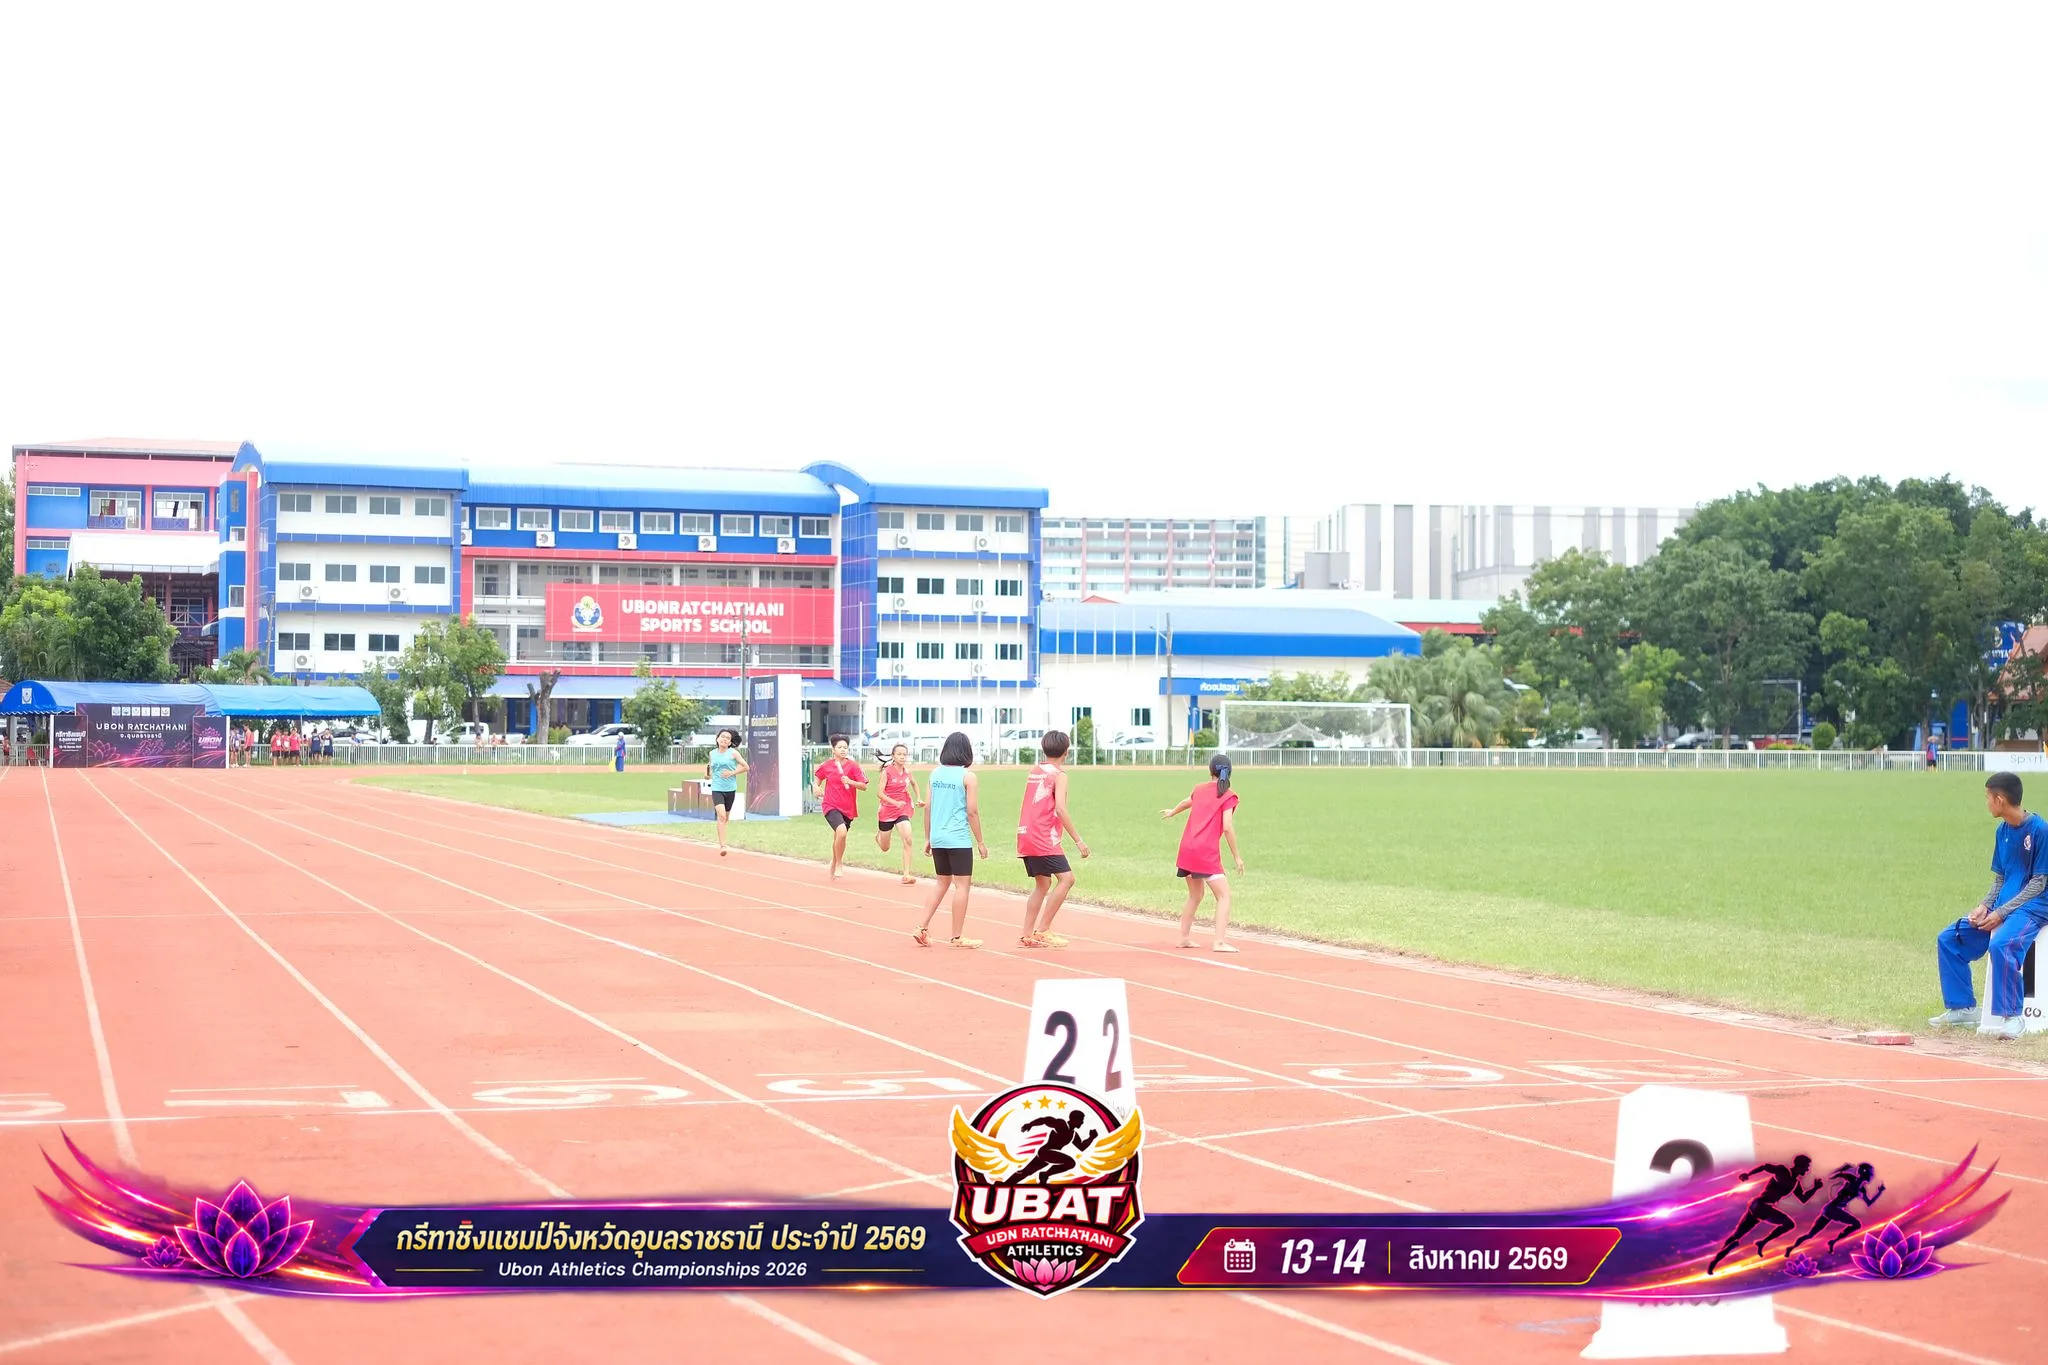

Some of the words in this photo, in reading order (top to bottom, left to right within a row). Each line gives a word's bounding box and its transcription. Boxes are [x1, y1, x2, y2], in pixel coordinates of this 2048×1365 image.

[622, 599, 784, 617] UBONRATCHATHANI
[640, 617, 703, 633] SPORTS
[709, 618, 772, 634] SCHOOL
[95, 722, 124, 731] UBON
[127, 722, 187, 732] RATCHATHANI
[2009, 753, 2043, 765] Sprt
[1042, 1010, 1078, 1085] 2
[1102, 1008, 1122, 1093] 2
